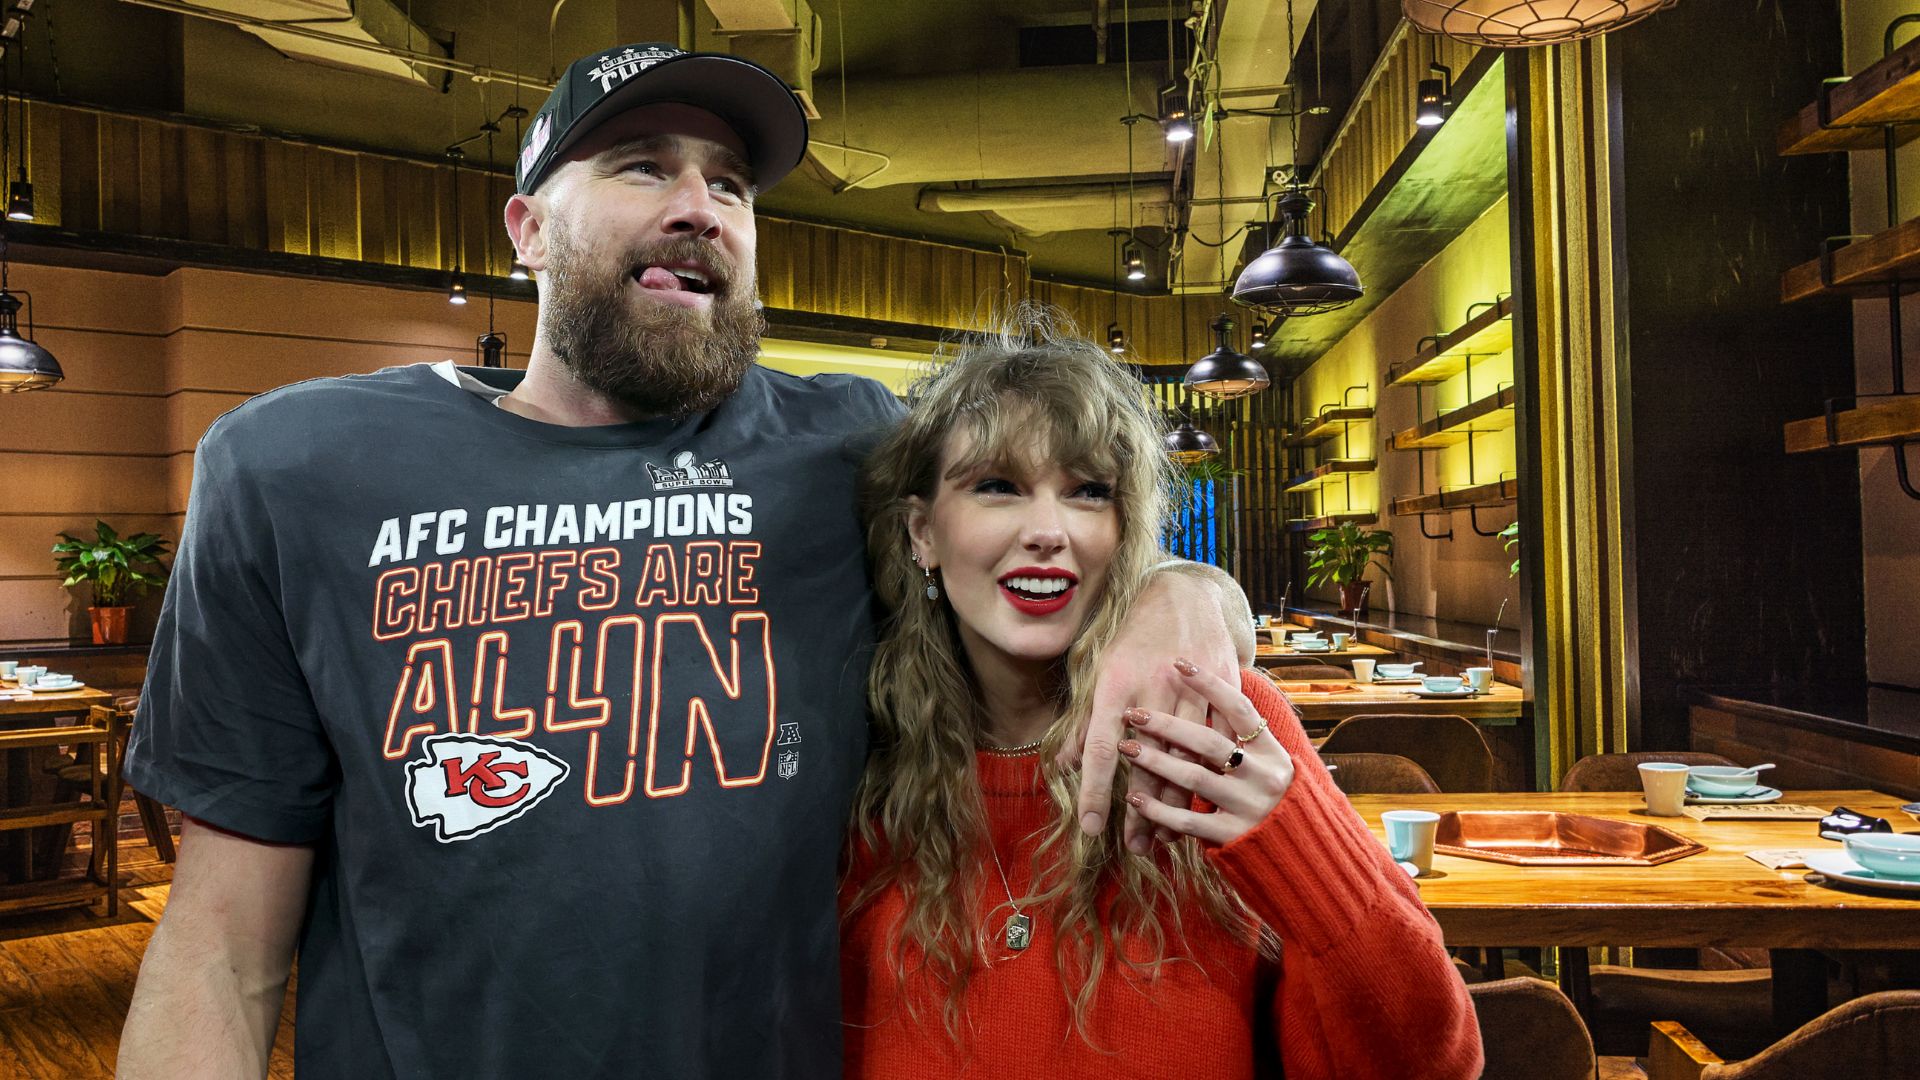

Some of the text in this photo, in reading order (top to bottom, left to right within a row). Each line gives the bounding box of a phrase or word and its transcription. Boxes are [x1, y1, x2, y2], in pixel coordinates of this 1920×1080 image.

[661, 480, 694, 488] SUPER
[368, 493, 753, 567] AFC CHAMPIONS
[374, 541, 761, 640] CHIEFS ARE
[383, 612, 777, 807] ALL IN
[440, 751, 531, 808] KC
[780, 762, 797, 775] NFL
